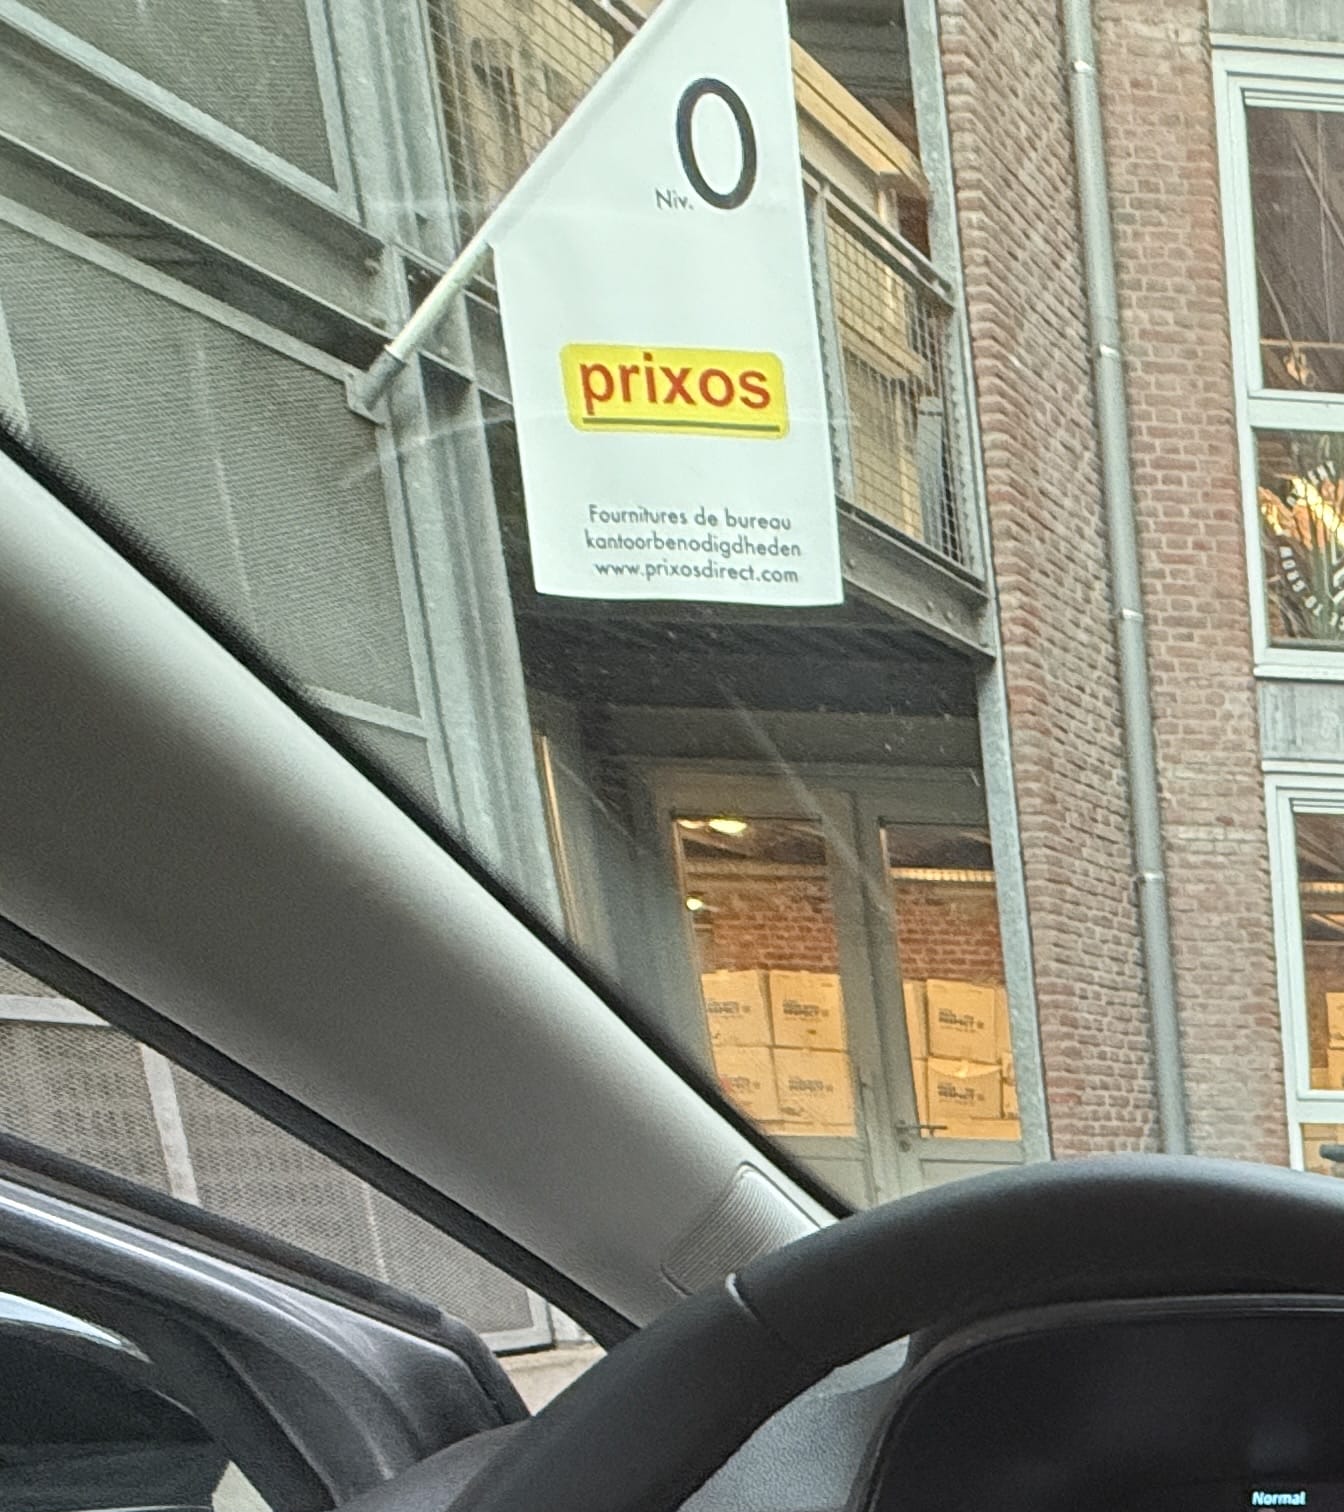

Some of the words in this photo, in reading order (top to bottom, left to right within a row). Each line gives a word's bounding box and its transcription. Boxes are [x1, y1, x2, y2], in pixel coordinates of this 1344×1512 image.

[655, 187, 695, 211] Niv.
[580, 352, 771, 415] prixos
[588, 503, 688, 525] Fournitures
[694, 505, 719, 527] de
[725, 507, 792, 531] bureau
[584, 529, 802, 559] kantoorbenodigdheden
[594, 558, 799, 583] www.prixosdirect.com
[1304, 595, 1324, 616] TO
[1252, 1491, 1306, 1505] Normal
